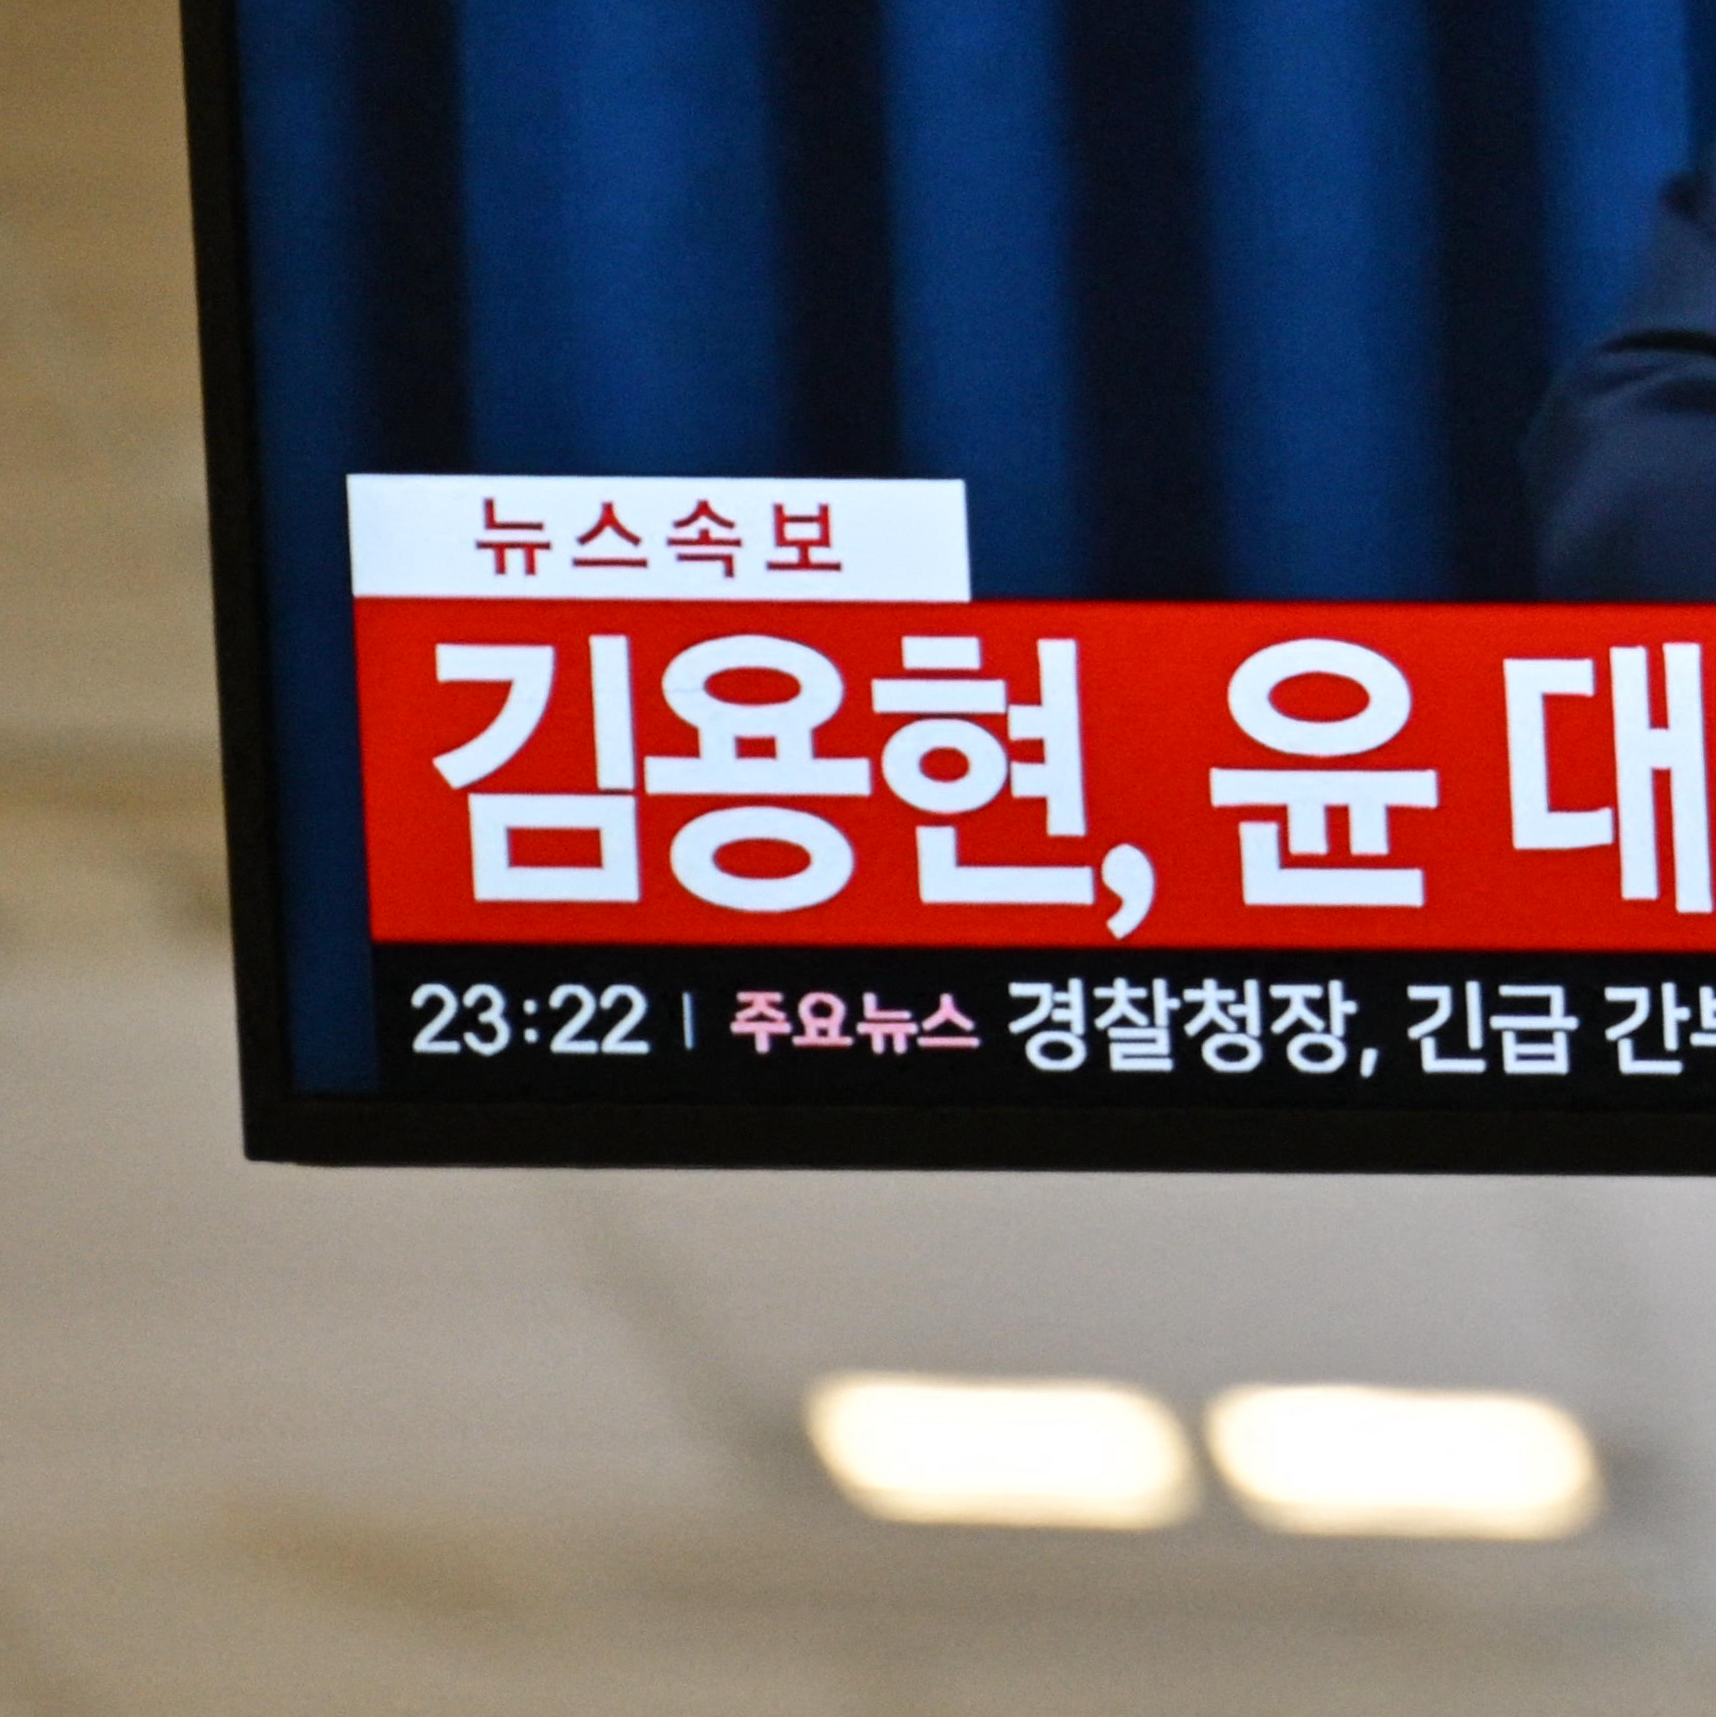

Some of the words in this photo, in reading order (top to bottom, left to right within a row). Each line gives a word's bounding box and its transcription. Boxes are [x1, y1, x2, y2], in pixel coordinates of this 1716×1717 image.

[475, 497, 843, 580] 뉴스속보
[432, 633, 1156, 940] 김용현,
[1208, 637, 1440, 909] 윤
[410, 982, 651, 1057] 23:22
[724, 989, 982, 1056] 주요뉴스
[1007, 976, 1380, 1079] 경찰청장,
[1406, 979, 1580, 1076] 긴급
